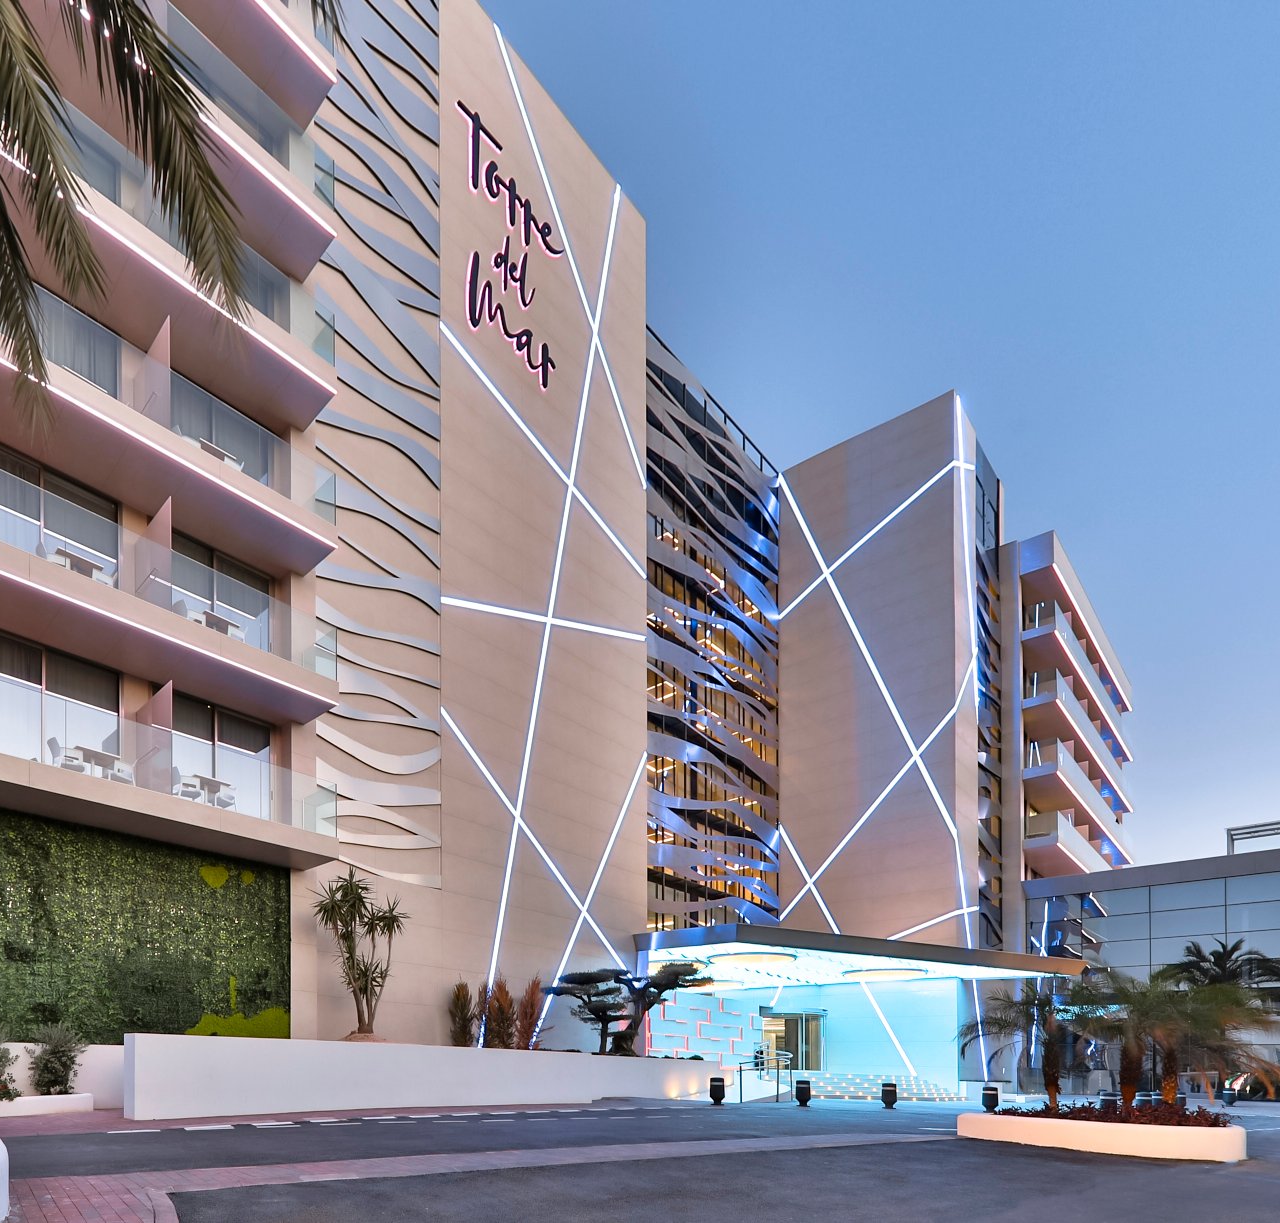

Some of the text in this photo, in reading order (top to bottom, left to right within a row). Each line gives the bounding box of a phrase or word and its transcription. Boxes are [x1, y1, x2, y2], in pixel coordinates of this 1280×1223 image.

[455, 99, 564, 255] Torre
[465, 250, 556, 391] Mar
[492, 235, 536, 309] del
